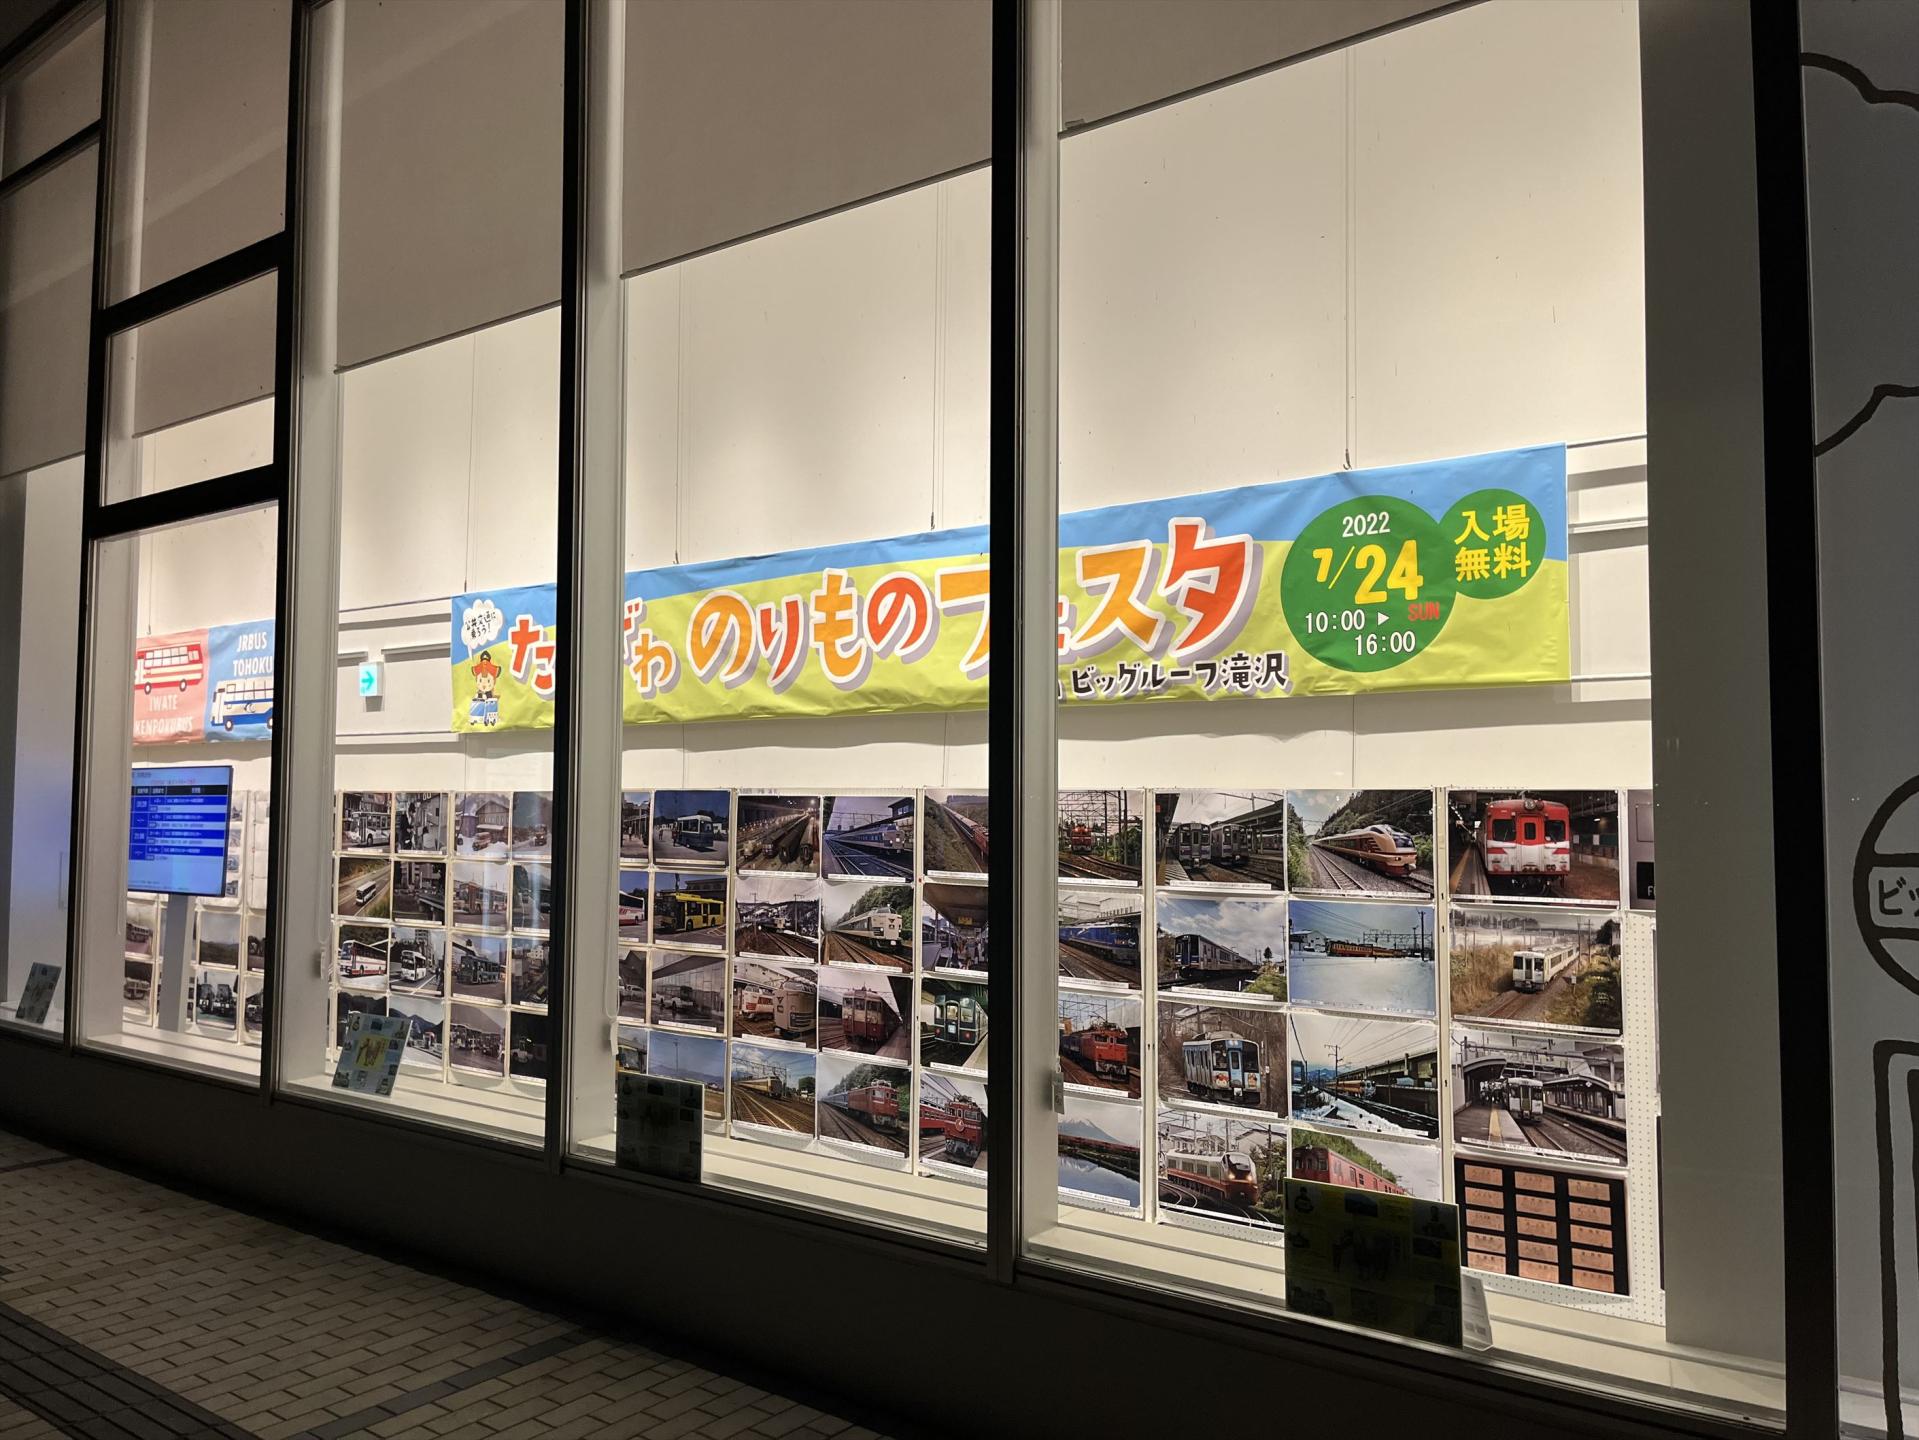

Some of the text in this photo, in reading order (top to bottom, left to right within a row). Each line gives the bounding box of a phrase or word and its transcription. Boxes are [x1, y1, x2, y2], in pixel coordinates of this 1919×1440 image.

[1342, 511, 1391, 538] 2022
[1454, 504, 1531, 545] 入場
[1312, 539, 1424, 605] 7/24
[1455, 542, 1532, 583] 無料
[1305, 609, 1365, 634] 10:00
[1408, 602, 1440, 622] SUN
[1355, 631, 1416, 656] 16:00
[232, 655, 273, 677] TOHOKU
[1071, 652, 1287, 695] ビッグルーフ滝沢
[148, 694, 178, 712] IWATE
